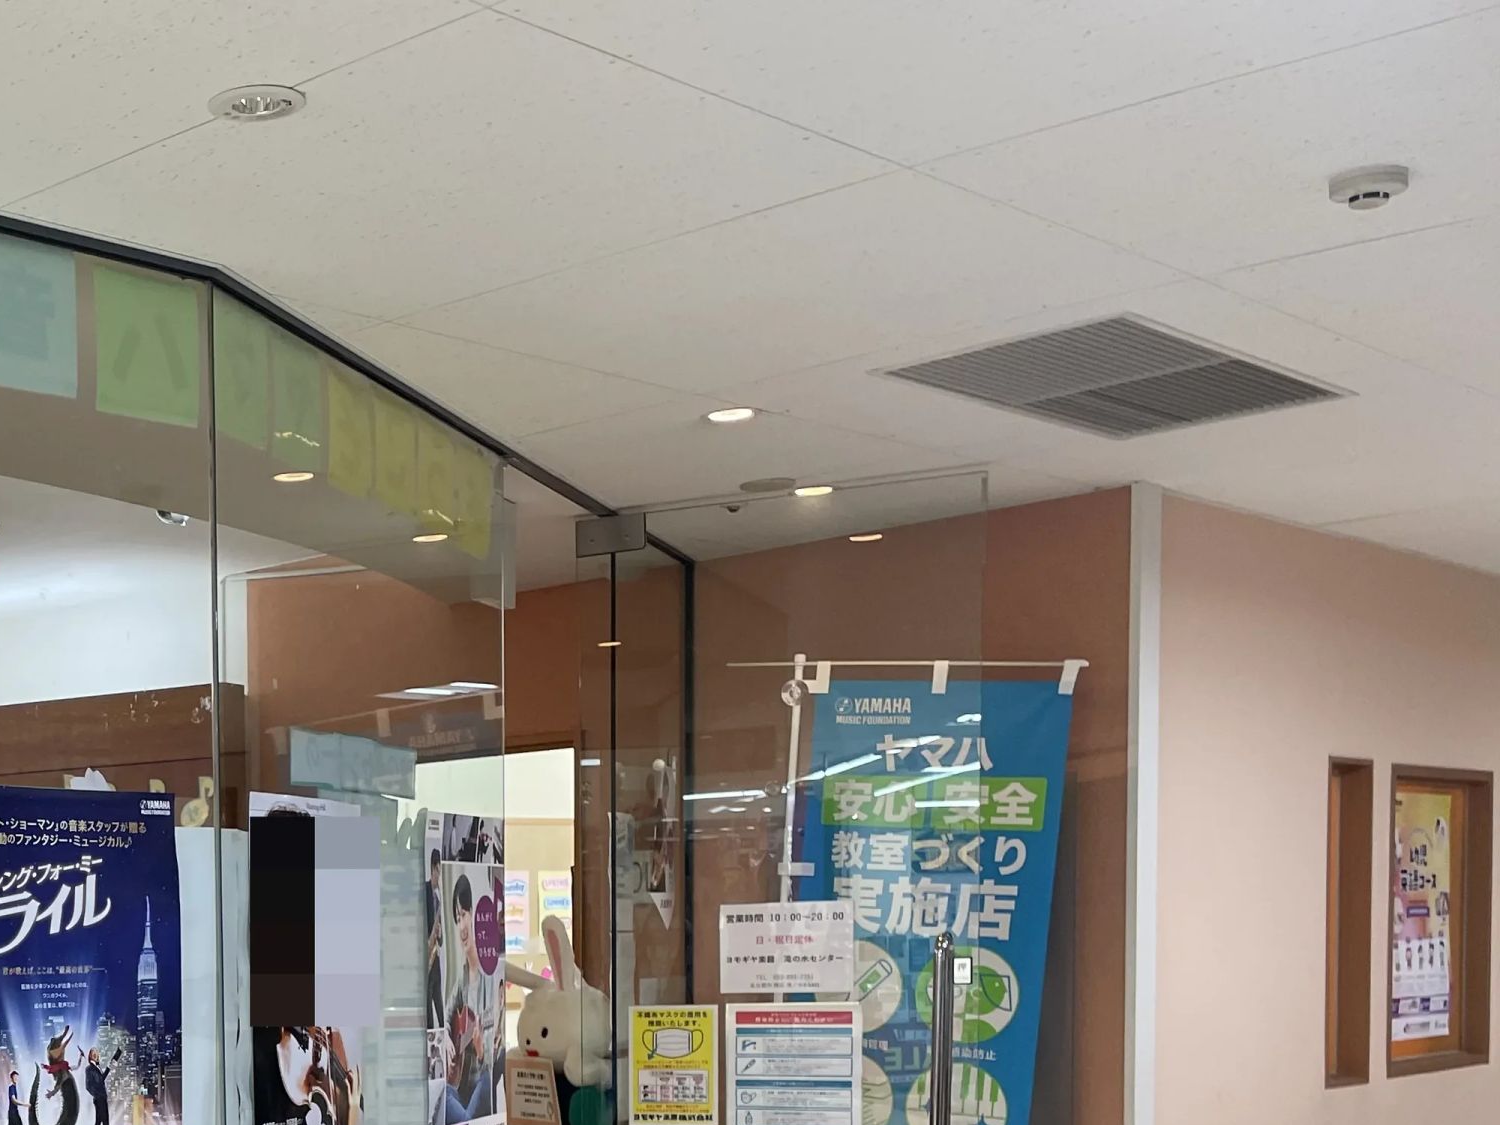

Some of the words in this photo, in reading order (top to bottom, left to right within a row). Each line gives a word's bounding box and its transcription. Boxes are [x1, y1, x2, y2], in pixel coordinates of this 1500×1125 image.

[854, 698, 912, 714] YAMAHA
[836, 715, 861, 725] MUSIC
[862, 716, 911, 725] FOUNDATION
[876, 734, 993, 772] ヤマハ
[146, 800, 171, 810] YAMAHA
[833, 779, 918, 823] 安心
[943, 782, 1038, 826] 安全
[831, 831, 1028, 876] 教室づくり
[726, 913, 764, 924] 営業時間
[833, 874, 1019, 941] 実施店
